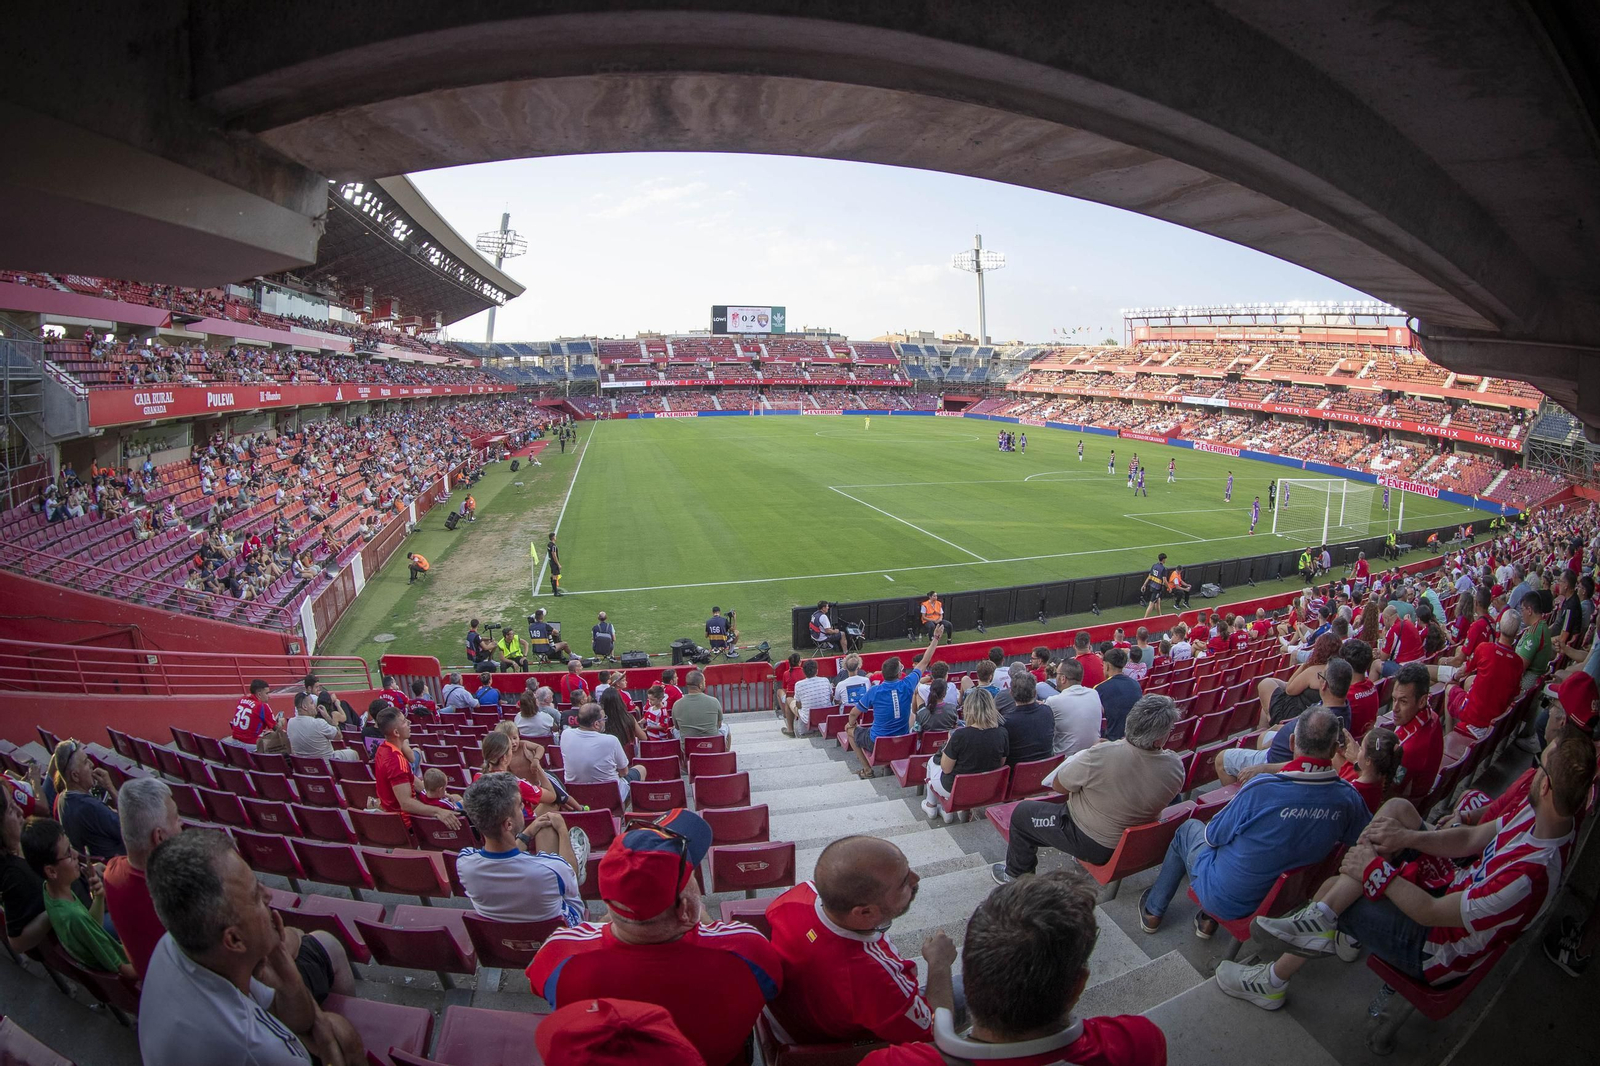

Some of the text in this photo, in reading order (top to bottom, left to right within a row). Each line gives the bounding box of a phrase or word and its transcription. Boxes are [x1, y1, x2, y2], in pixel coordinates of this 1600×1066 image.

[134, 391, 174, 406] CAJA RURAL
[207, 392, 235, 407] PULEVA
[1154, 394, 1182, 402] MATRIX
[143, 405, 167, 415] GRANADA
[1230, 401, 1263, 410] MATRIX
[1275, 406, 1310, 415] MATRIX
[1322, 411, 1360, 422] MATRIX
[1363, 416, 1402, 428] MATRIX
[1417, 425, 1459, 438] MATRIX
[1474, 434, 1518, 449] MATRIX
[1200, 443, 1240, 457] ENERDRINK
[1387, 476, 1438, 497] ENERDRINK
[530, 630, 541, 638] 149
[233, 704, 253, 731] 35
[1280, 807, 1342, 821] GRANADA CF
